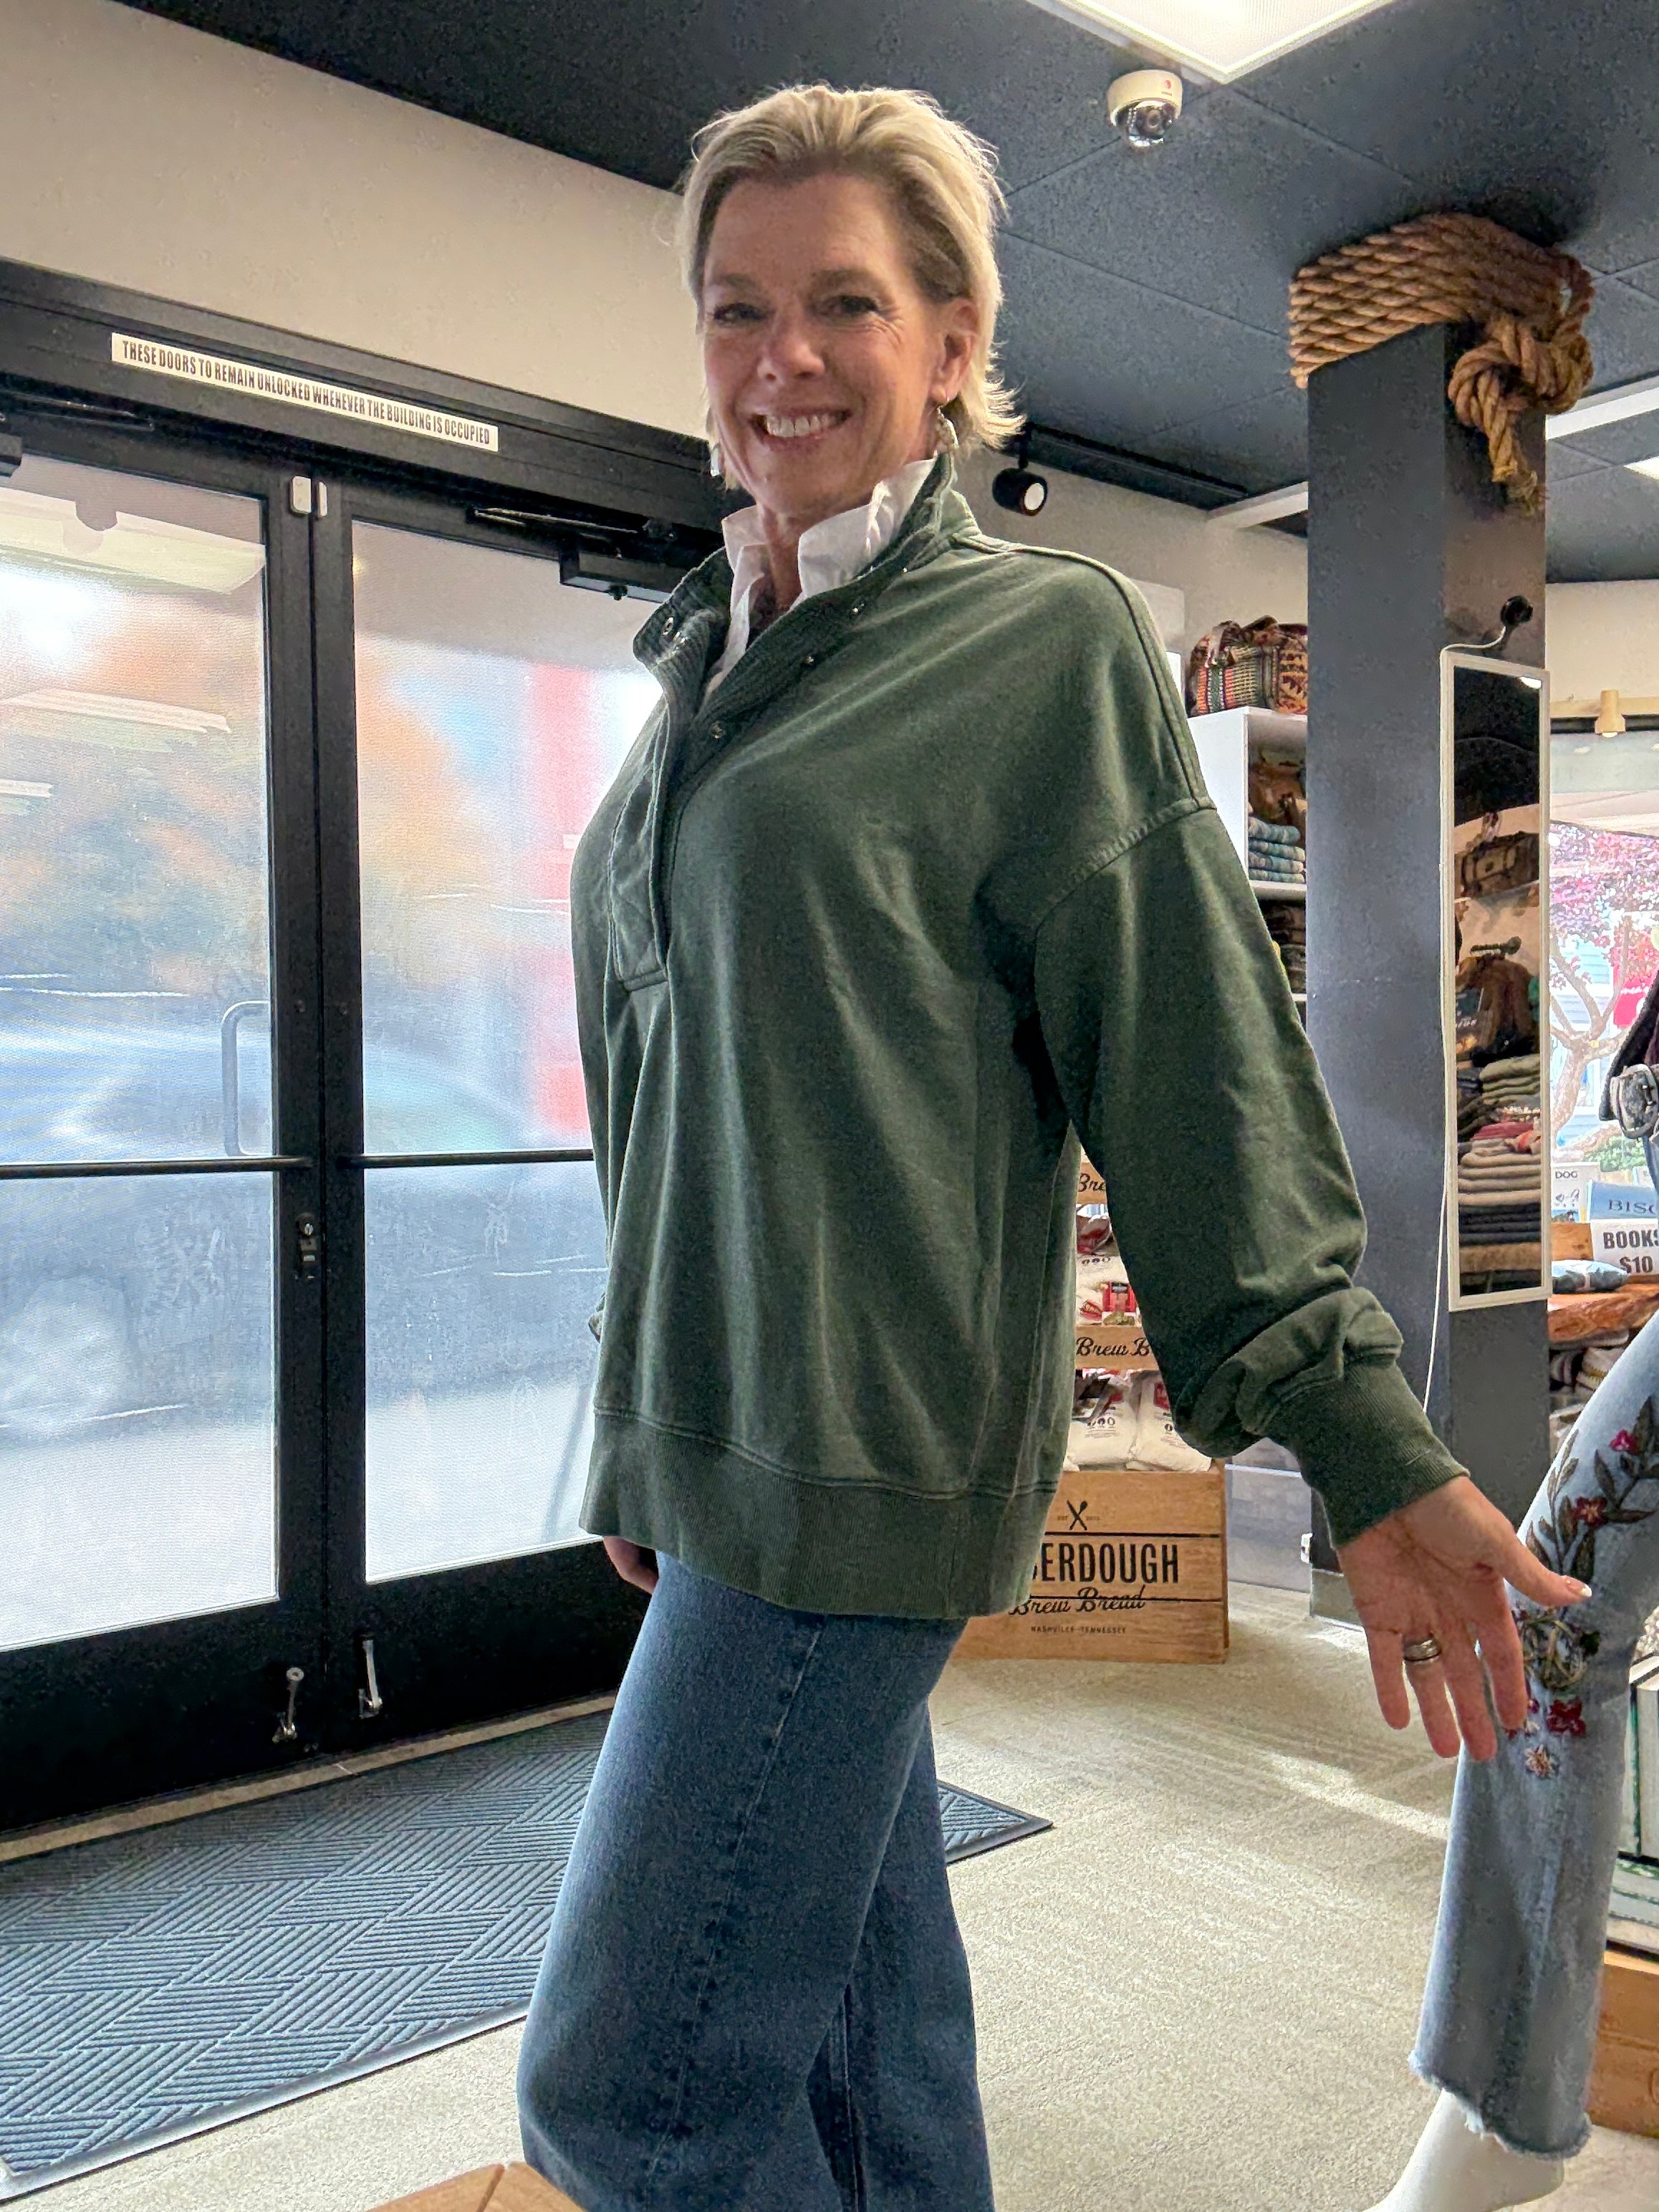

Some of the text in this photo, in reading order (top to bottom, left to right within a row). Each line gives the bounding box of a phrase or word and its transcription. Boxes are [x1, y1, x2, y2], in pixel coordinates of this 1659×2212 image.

[122, 340, 490, 445] THESE DOORS TO REMAIN UNLOCKED WHENEVER THE BUILDING IS OCCUPIED
[1620, 1256, 1653, 1274] $10
[1076, 1336, 1129, 1356] Brew
